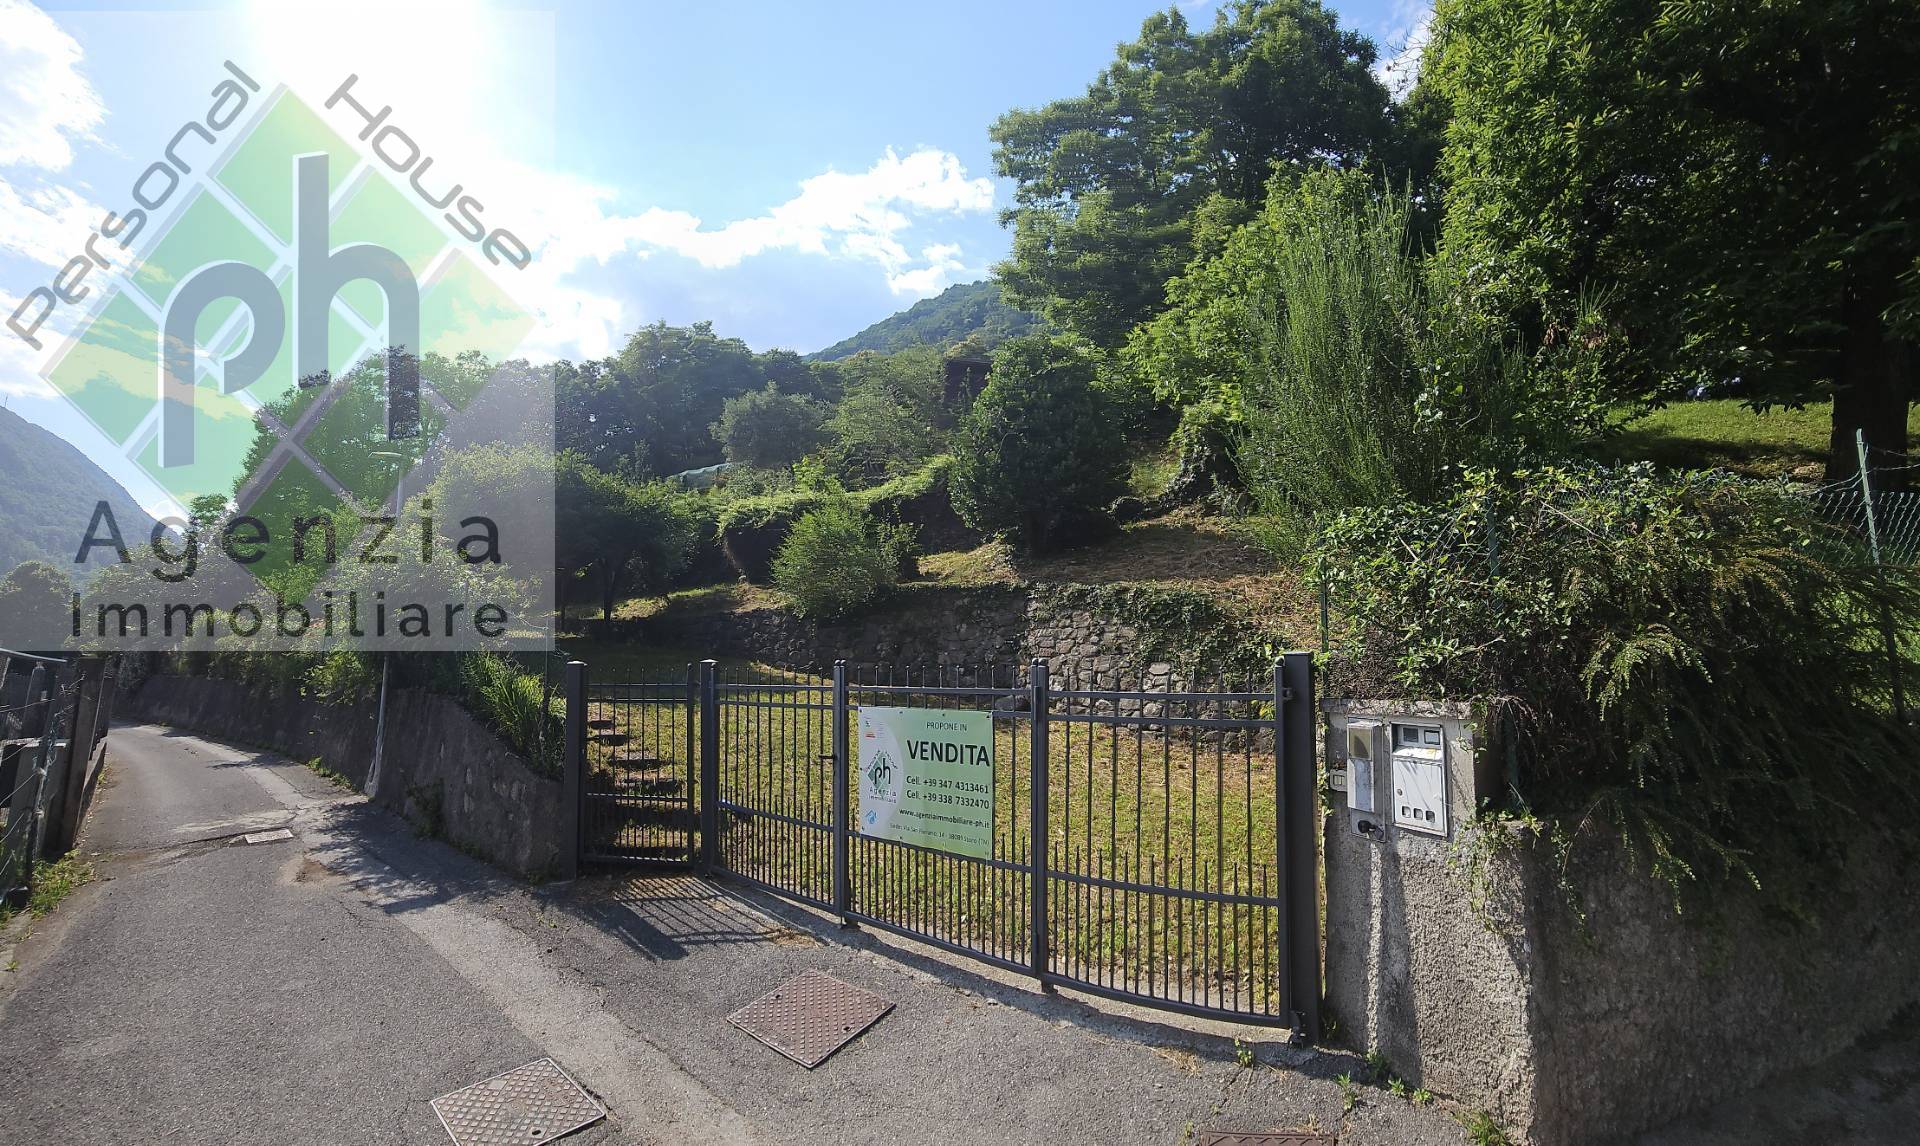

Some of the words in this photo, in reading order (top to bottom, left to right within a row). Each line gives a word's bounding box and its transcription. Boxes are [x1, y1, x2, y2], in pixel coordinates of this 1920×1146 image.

[926, 721, 958, 731] PROPONE
[959, 723, 968, 732] IN
[906, 739, 990, 767] VENDITA
[923, 778, 937, 788] +39
[938, 779, 953, 789] 347
[955, 781, 989, 794] 4313461
[923, 793, 937, 803] +39
[938, 794, 953, 805] 338
[956, 796, 990, 809] 7332470
